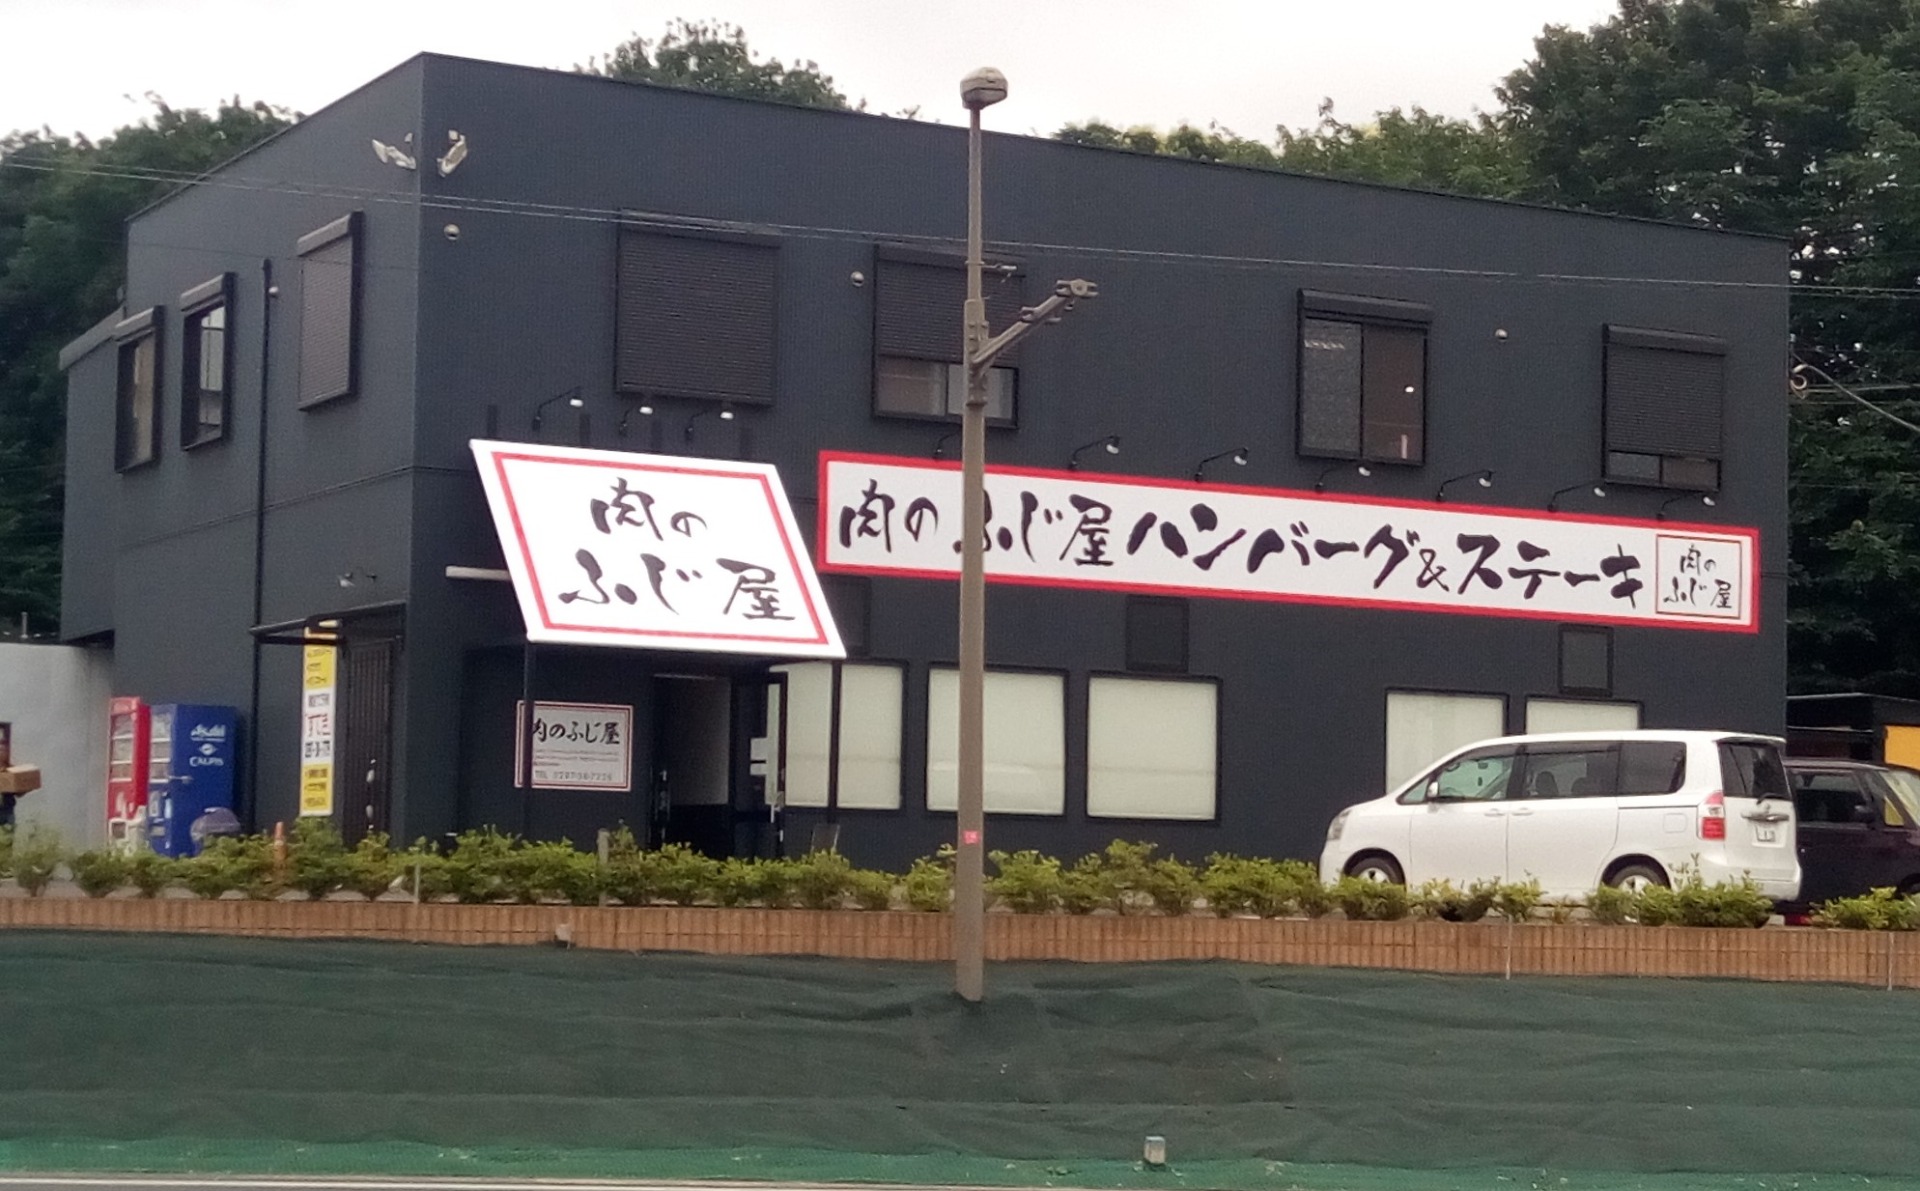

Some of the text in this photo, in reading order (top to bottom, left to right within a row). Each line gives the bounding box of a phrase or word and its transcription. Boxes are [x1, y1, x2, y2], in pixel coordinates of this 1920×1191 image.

[590, 477, 708, 541] 肉の
[1679, 542, 1717, 575] 肉の
[558, 548, 796, 622] ふじ屋
[1663, 576, 1734, 609] ふじ屋
